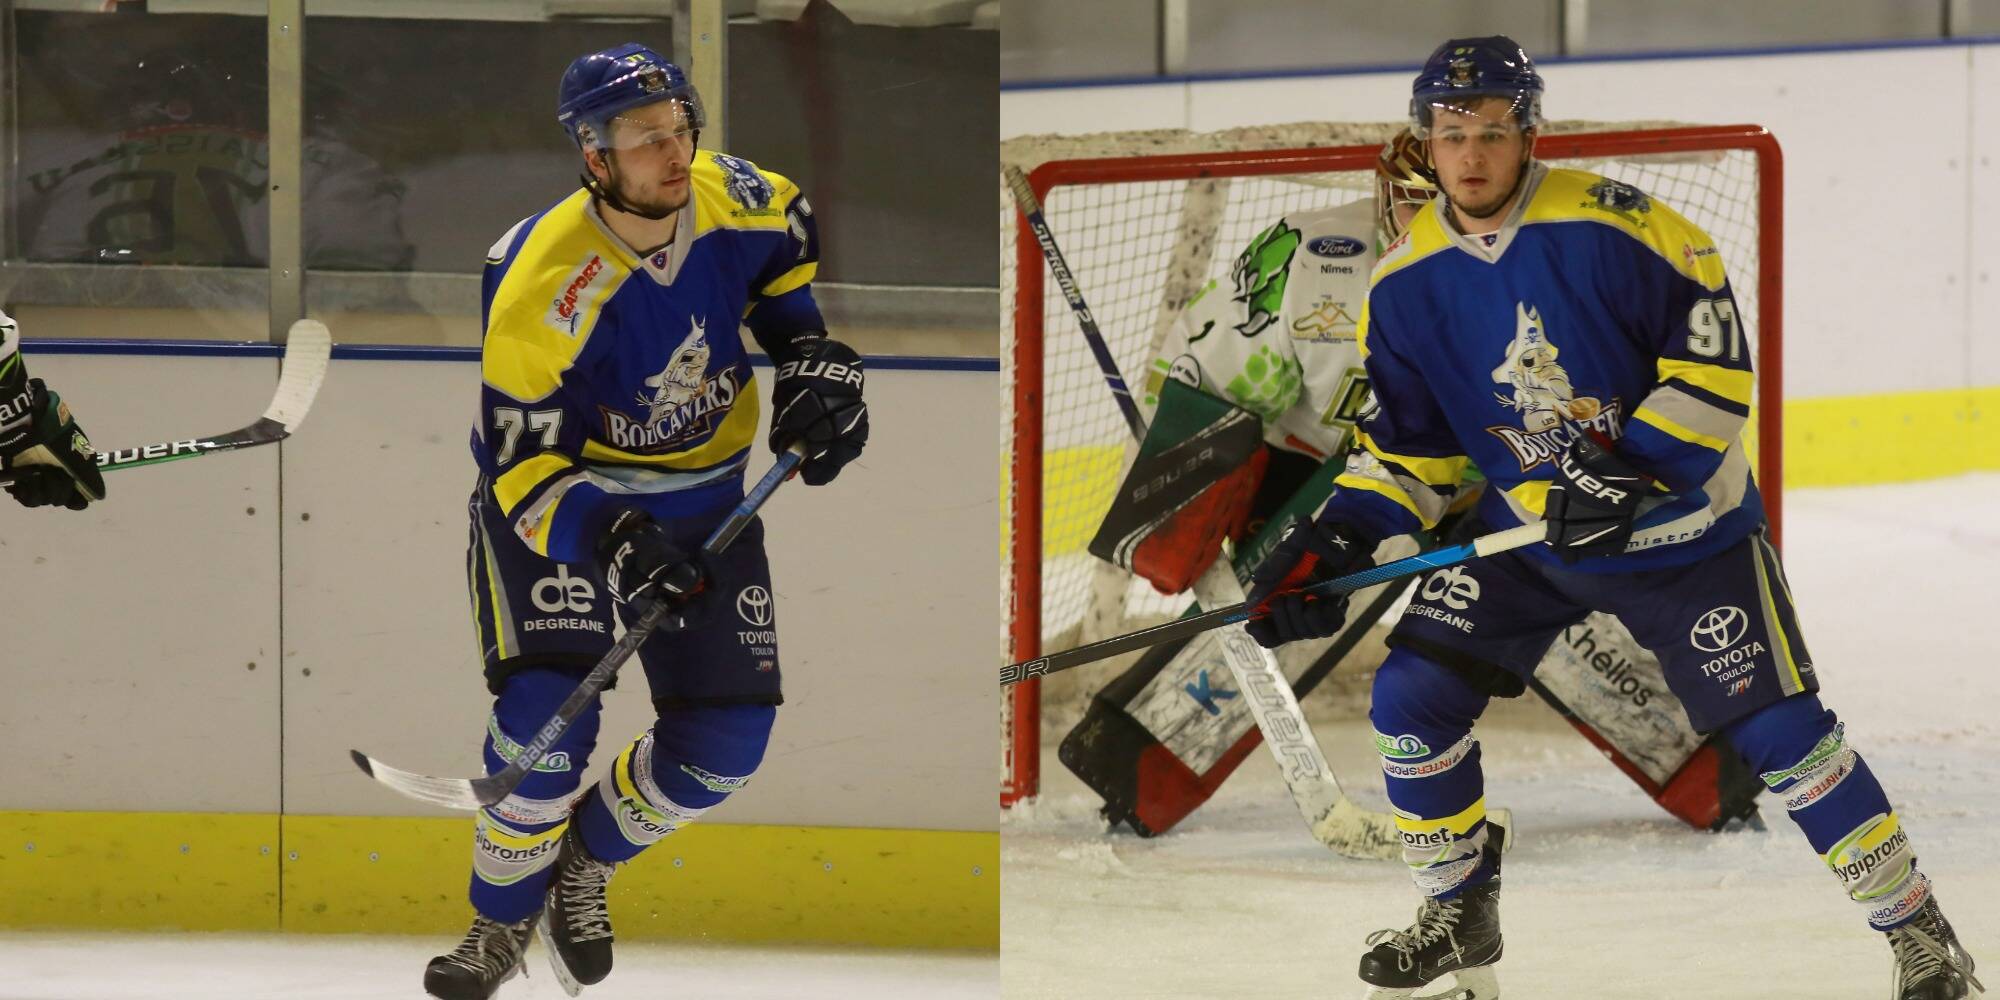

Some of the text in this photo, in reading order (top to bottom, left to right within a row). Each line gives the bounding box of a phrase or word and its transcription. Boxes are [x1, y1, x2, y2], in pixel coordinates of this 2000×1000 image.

[1318, 239, 1355, 255] Ford
[558, 255, 603, 318] GAPORT
[1687, 299, 1740, 361] 97
[777, 360, 863, 390] AUER
[494, 406, 562, 466] 77
[1561, 454, 1628, 505] UER
[530, 563, 596, 613] de
[524, 618, 606, 633] DEGREANE
[1405, 604, 1475, 634] DEGREANE
[1700, 641, 1766, 678] TOYOTA
[1716, 660, 1756, 684] TOULON
[1222, 624, 1322, 784] AUER
[516, 715, 568, 771] BAUER
